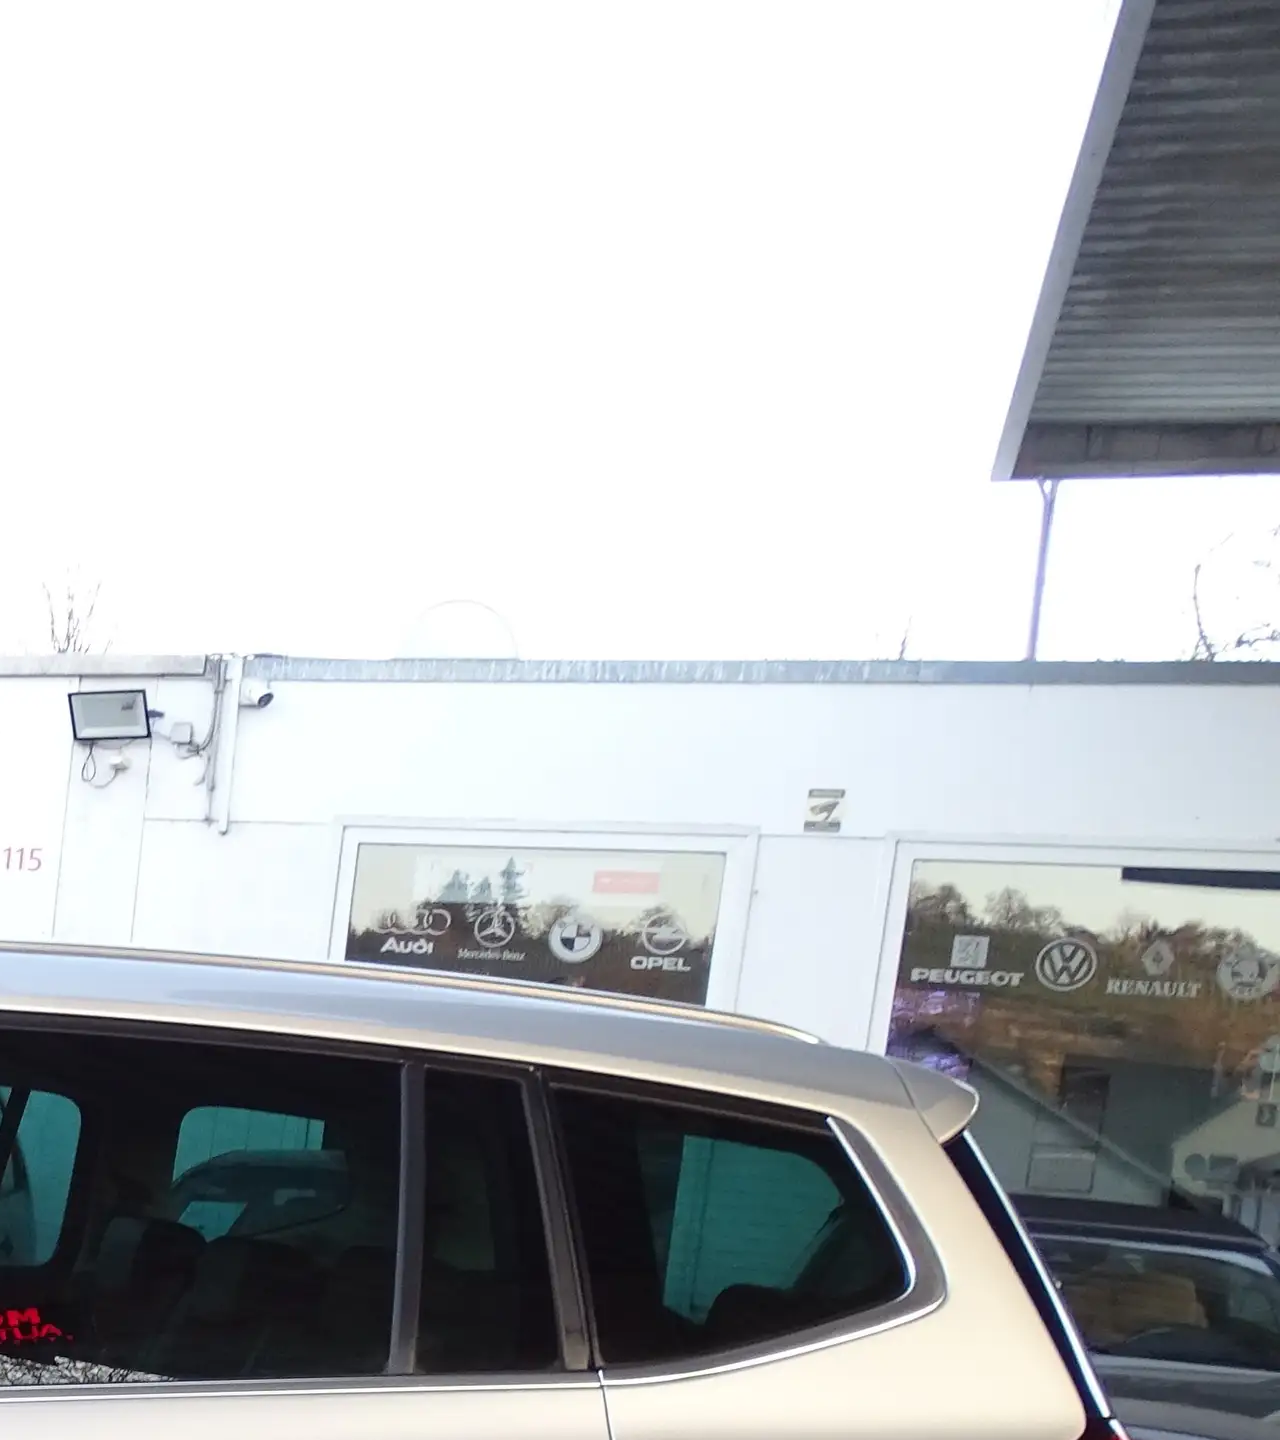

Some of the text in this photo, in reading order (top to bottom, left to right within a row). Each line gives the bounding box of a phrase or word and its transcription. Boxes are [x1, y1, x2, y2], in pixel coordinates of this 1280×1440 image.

[3, 846, 42, 871] 115
[380, 936, 434, 956] Audi
[630, 955, 692, 972] OPEL
[910, 967, 1025, 988] PEUGEOT
[1106, 979, 1202, 998] RENAULT
